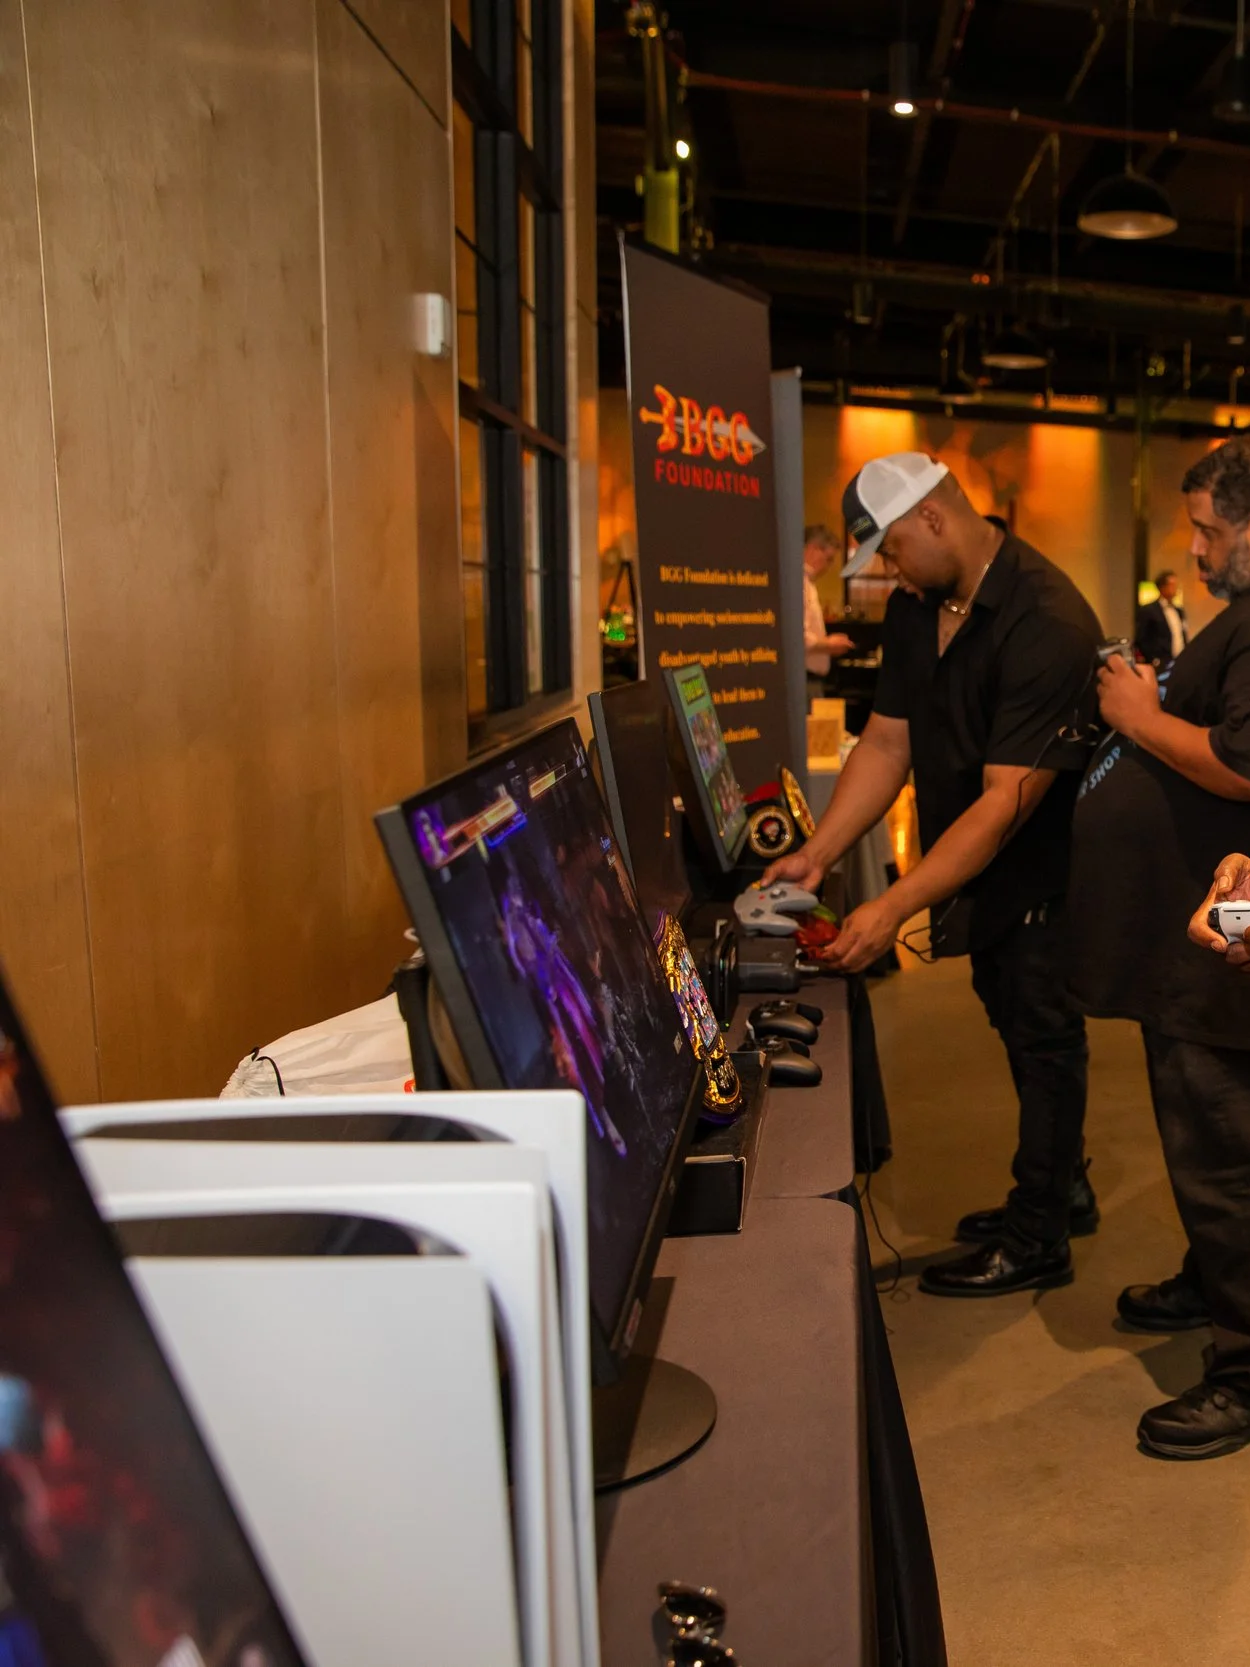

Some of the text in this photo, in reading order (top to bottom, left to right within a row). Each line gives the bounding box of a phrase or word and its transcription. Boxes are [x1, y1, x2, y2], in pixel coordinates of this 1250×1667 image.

[680, 396, 754, 466] BGG
[654, 458, 760, 498] FOUNDATION
[660, 565, 682, 583] BGG
[684, 565, 727, 585] Foundation
[666, 608, 715, 628] empowering
[1089, 745, 1121, 790] SHOP
